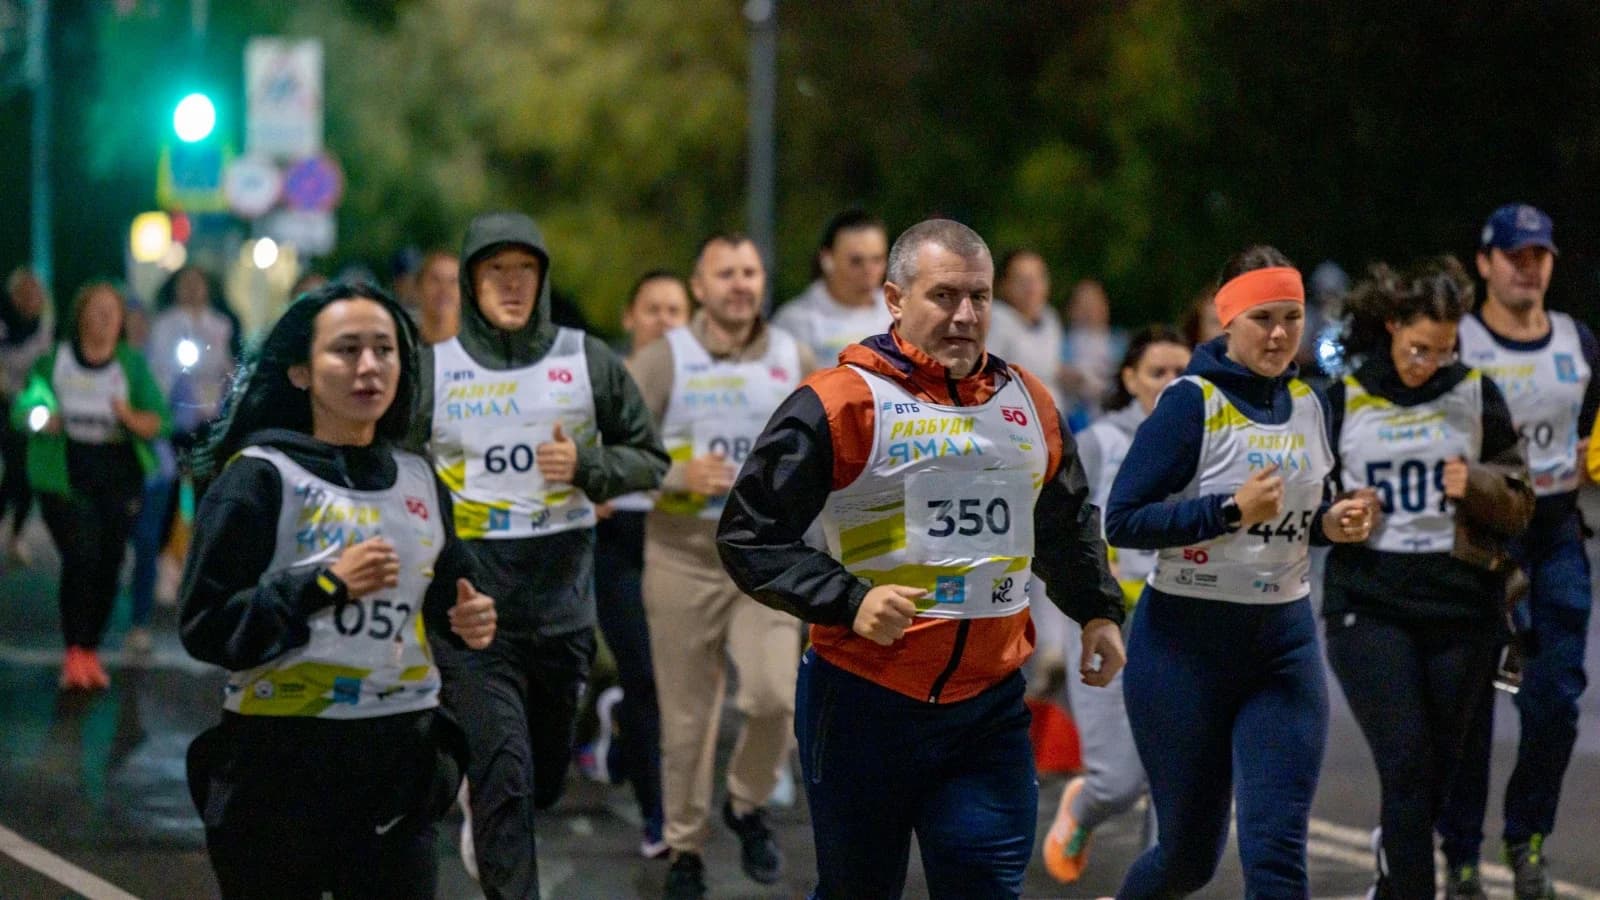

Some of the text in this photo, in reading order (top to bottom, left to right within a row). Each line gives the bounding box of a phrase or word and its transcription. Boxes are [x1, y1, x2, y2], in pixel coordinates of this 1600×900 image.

[894, 403, 920, 414] ВТБ
[1001, 408, 1028, 427] 50
[889, 416, 976, 441] РАЗБУДИ
[485, 445, 534, 474] 60
[886, 436, 984, 467] ЯМАЛ
[927, 497, 1010, 537] 350
[1183, 549, 1209, 565] 50
